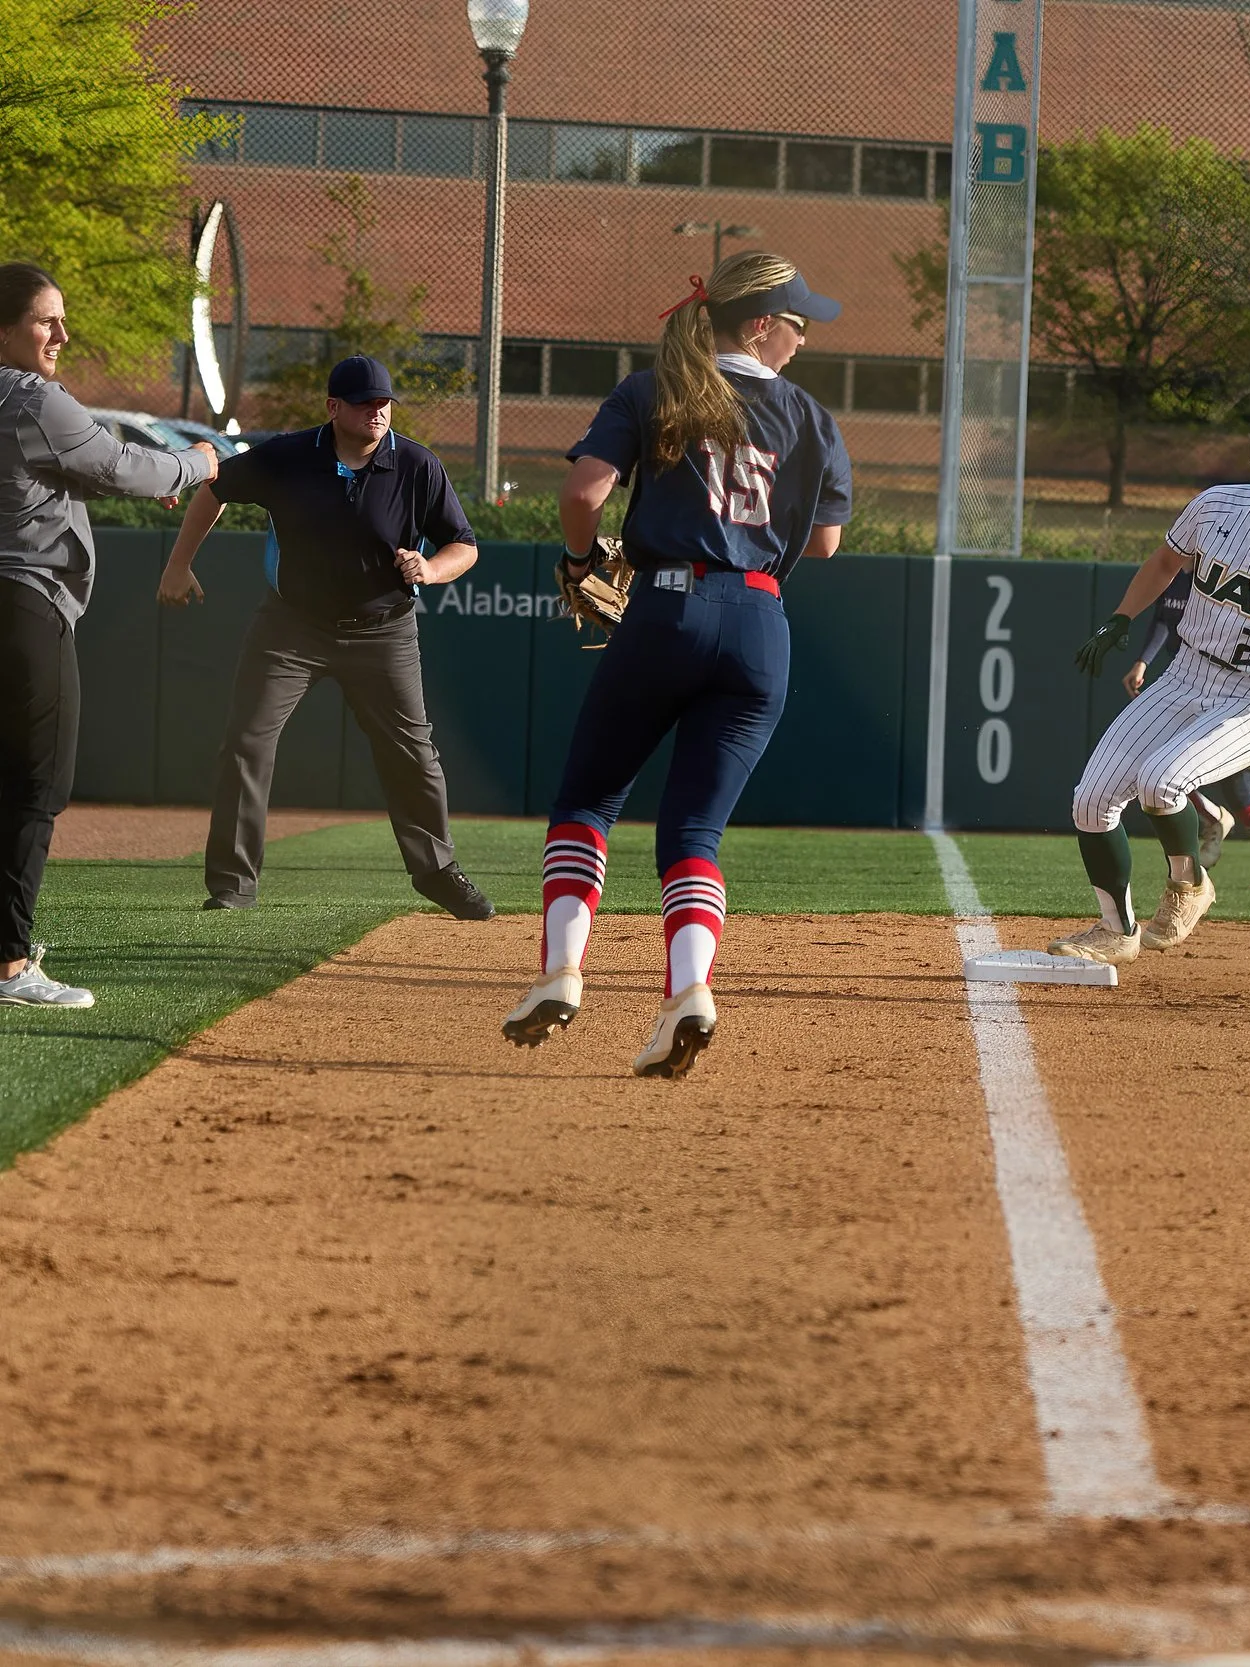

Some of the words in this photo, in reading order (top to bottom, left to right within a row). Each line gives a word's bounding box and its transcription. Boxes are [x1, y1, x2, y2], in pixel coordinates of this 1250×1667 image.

[975, 0, 1028, 183] AB
[699, 438, 779, 527] 15
[437, 583, 562, 617] Alabam
[976, 575, 1015, 785] 200
